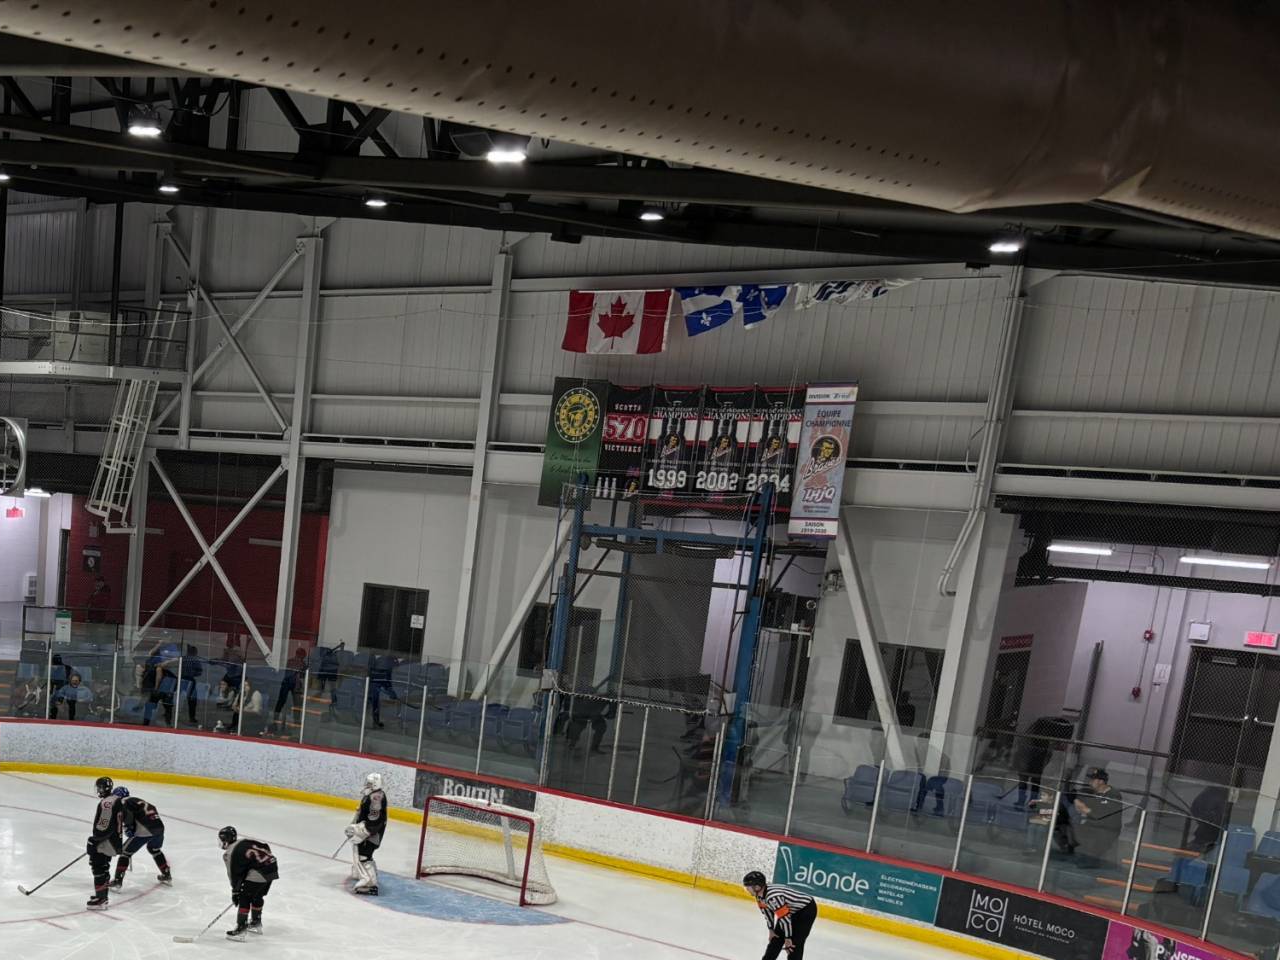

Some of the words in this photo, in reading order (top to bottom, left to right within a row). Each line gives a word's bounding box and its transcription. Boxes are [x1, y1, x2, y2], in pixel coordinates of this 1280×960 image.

[605, 414, 646, 440] 570
[648, 469, 687, 488] 1999
[696, 471, 739, 490] 2002
[1013, 914, 1044, 930] HÔTEL
[1045, 922, 1076, 939] MOCO
